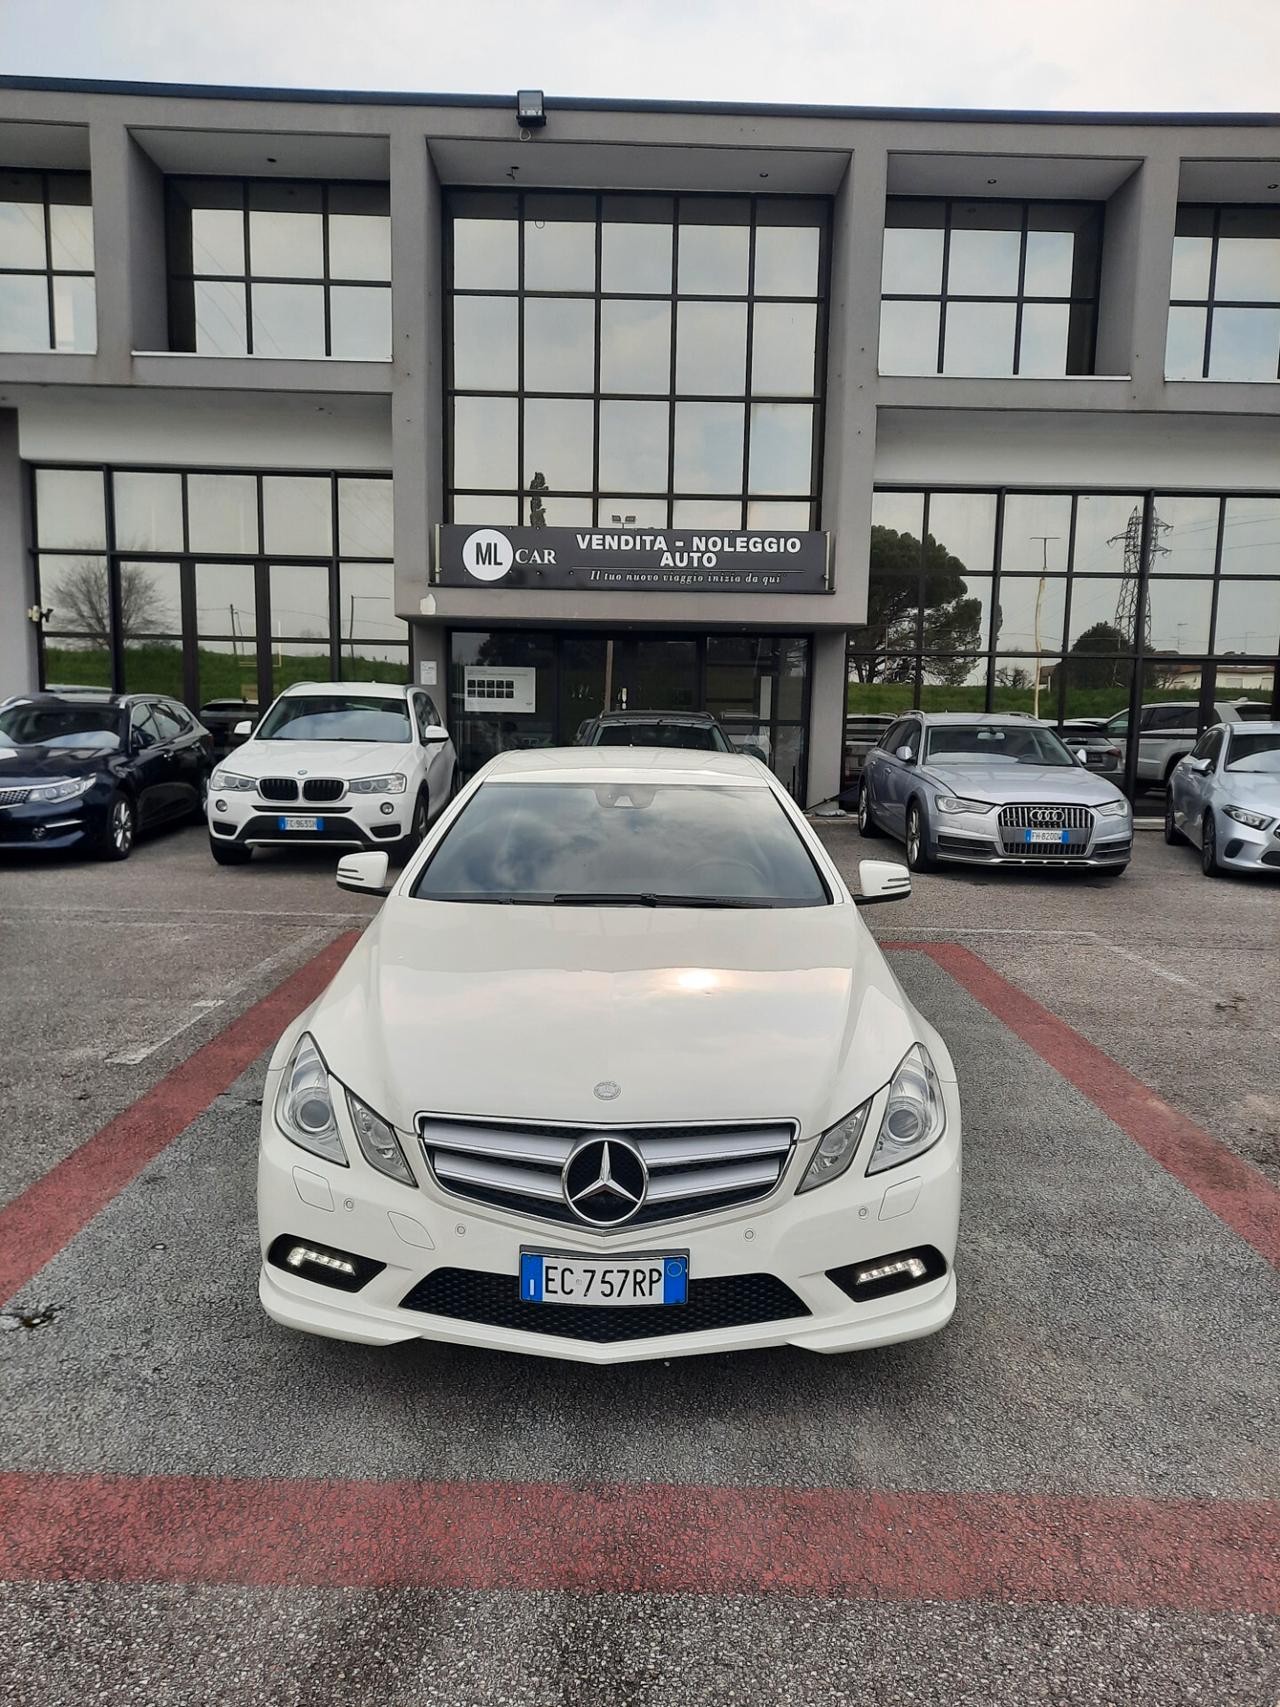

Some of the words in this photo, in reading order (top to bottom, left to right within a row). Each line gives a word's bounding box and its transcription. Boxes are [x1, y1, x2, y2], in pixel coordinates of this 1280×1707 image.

[576, 534, 668, 550] VENDITA
[692, 536, 801, 553] NOLEGGIO
[475, 542, 503, 566] ML
[515, 548, 557, 564] CAR
[660, 552, 717, 568] AUTO
[590, 570, 601, 581] Il
[604, 572, 622, 581] tuo
[626, 573, 659, 581] nuovo
[663, 571, 704, 585] viaggio
[708, 572, 741, 583] inizia
[745, 573, 759, 583] da
[762, 573, 781, 586] qui
